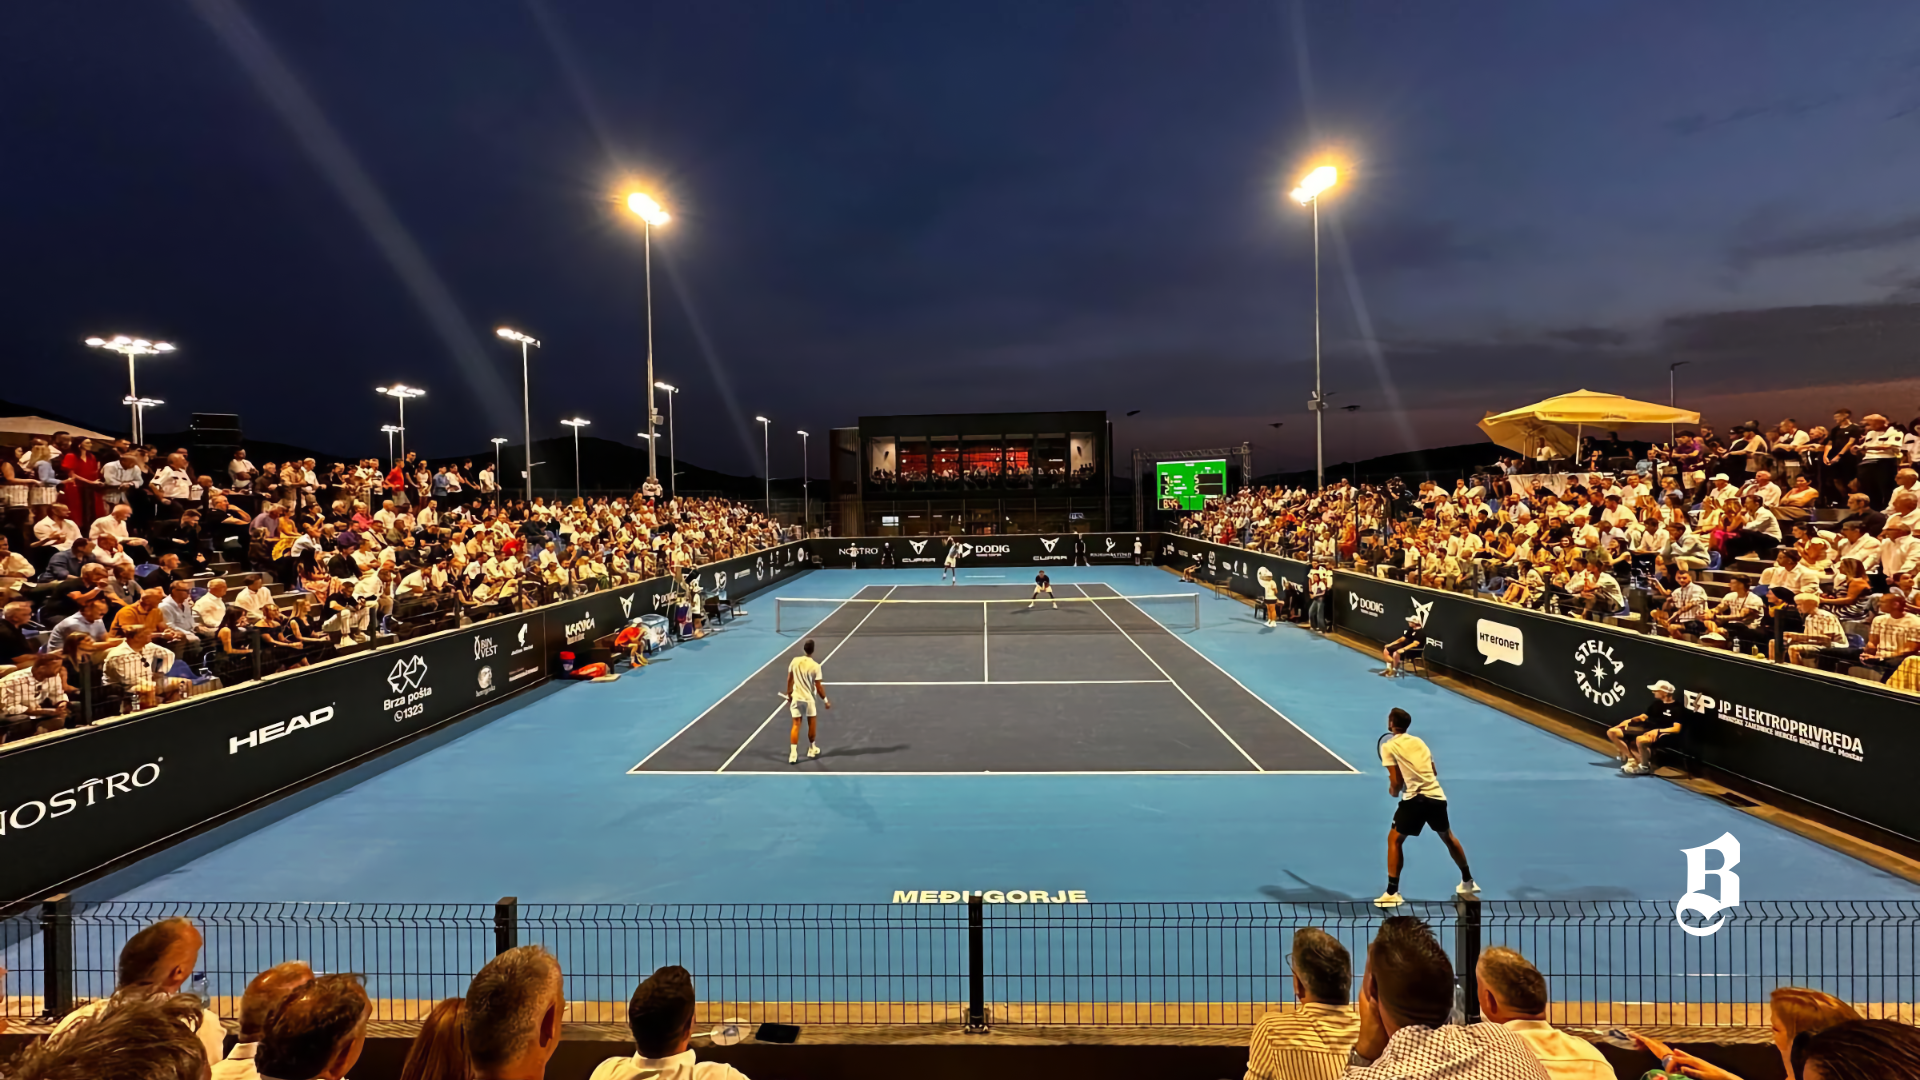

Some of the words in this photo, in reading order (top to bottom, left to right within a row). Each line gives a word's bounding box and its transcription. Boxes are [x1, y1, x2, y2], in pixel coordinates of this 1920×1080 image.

[976, 545, 1010, 553] DODIG
[1360, 597, 1384, 614] DODIG
[481, 644, 498, 658] VEST
[1574, 639, 1624, 675] STELLA
[384, 696, 405, 711] Brza
[408, 687, 432, 705] pošta
[1574, 670, 1626, 707] ARTOIS
[403, 703, 423, 719] 1323
[229, 706, 334, 755] HEAD
[1718, 699, 1732, 714] JP
[1735, 704, 1864, 755] ELEKTROPRIVREDA
[0, 762, 161, 835] OSTRO
